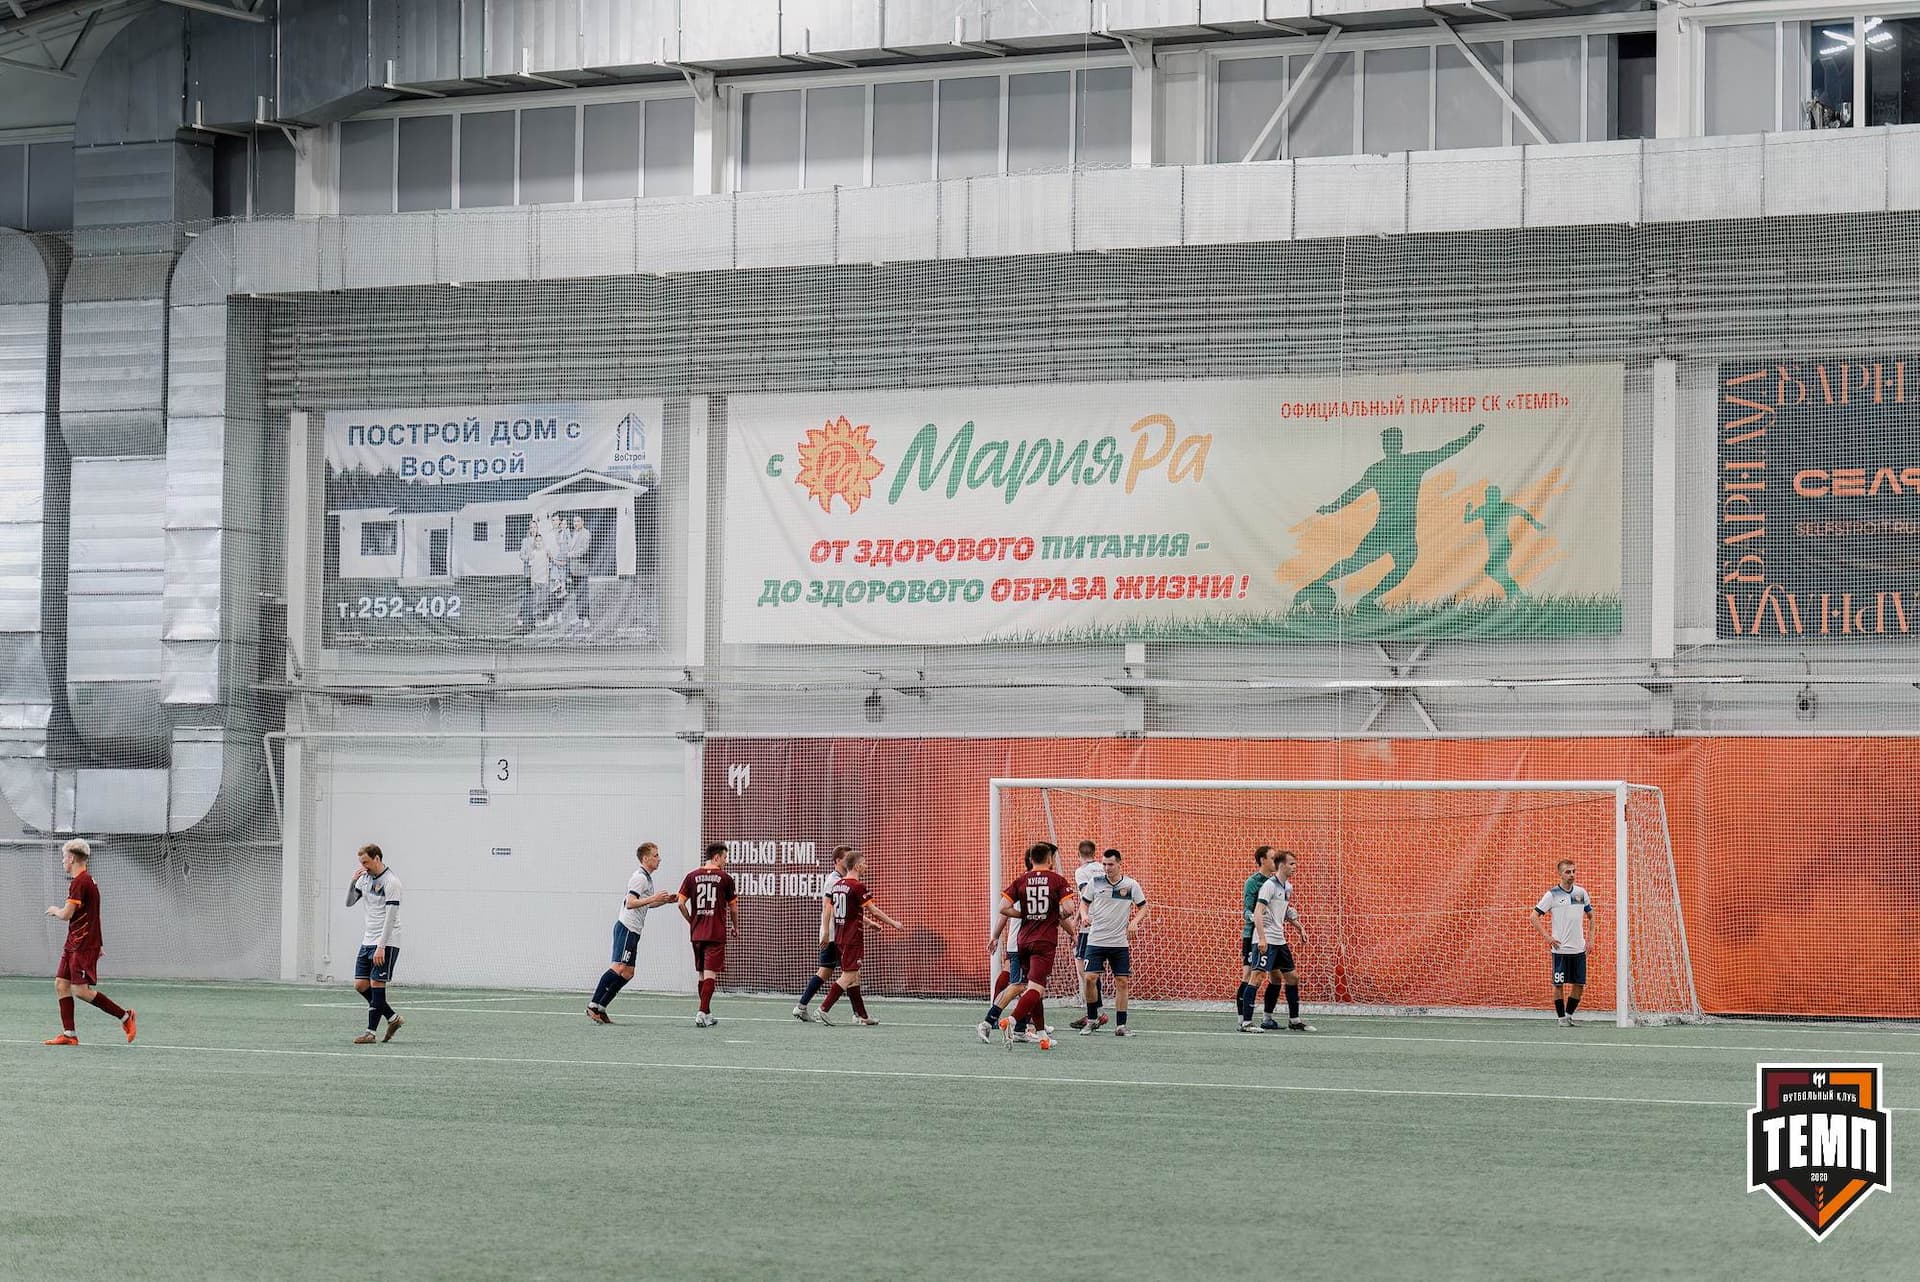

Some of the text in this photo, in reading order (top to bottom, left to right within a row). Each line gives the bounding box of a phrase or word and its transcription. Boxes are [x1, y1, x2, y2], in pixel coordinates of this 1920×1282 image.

[1281, 392, 1568, 421] ОФИЦИАЛЬНЫЙ ПАРТНЕР СК «ТЕМП»
[348, 416, 481, 446] ПОСТРОЙ
[490, 418, 557, 446] ДОМ
[400, 452, 525, 479] ВоСтрой
[809, 539, 850, 564] ОТ
[854, 537, 1036, 567] ЗДОРОВОГО
[1041, 534, 1190, 561] ПИТАНИЯ
[757, 578, 802, 608] ДО
[806, 578, 984, 607] ЗДОРОВОГО
[990, 575, 1109, 603] ОБРАЗА
[336, 596, 461, 619] т.252-402
[497, 758, 510, 781] 3
[780, 841, 819, 867] ТЕМП,
[696, 882, 717, 909] 24
[731, 873, 827, 899] ОЛЬКО ПОБЕД
[1026, 885, 1049, 914] 55
[832, 892, 847, 918] 20
[1554, 972, 1564, 983] 96
